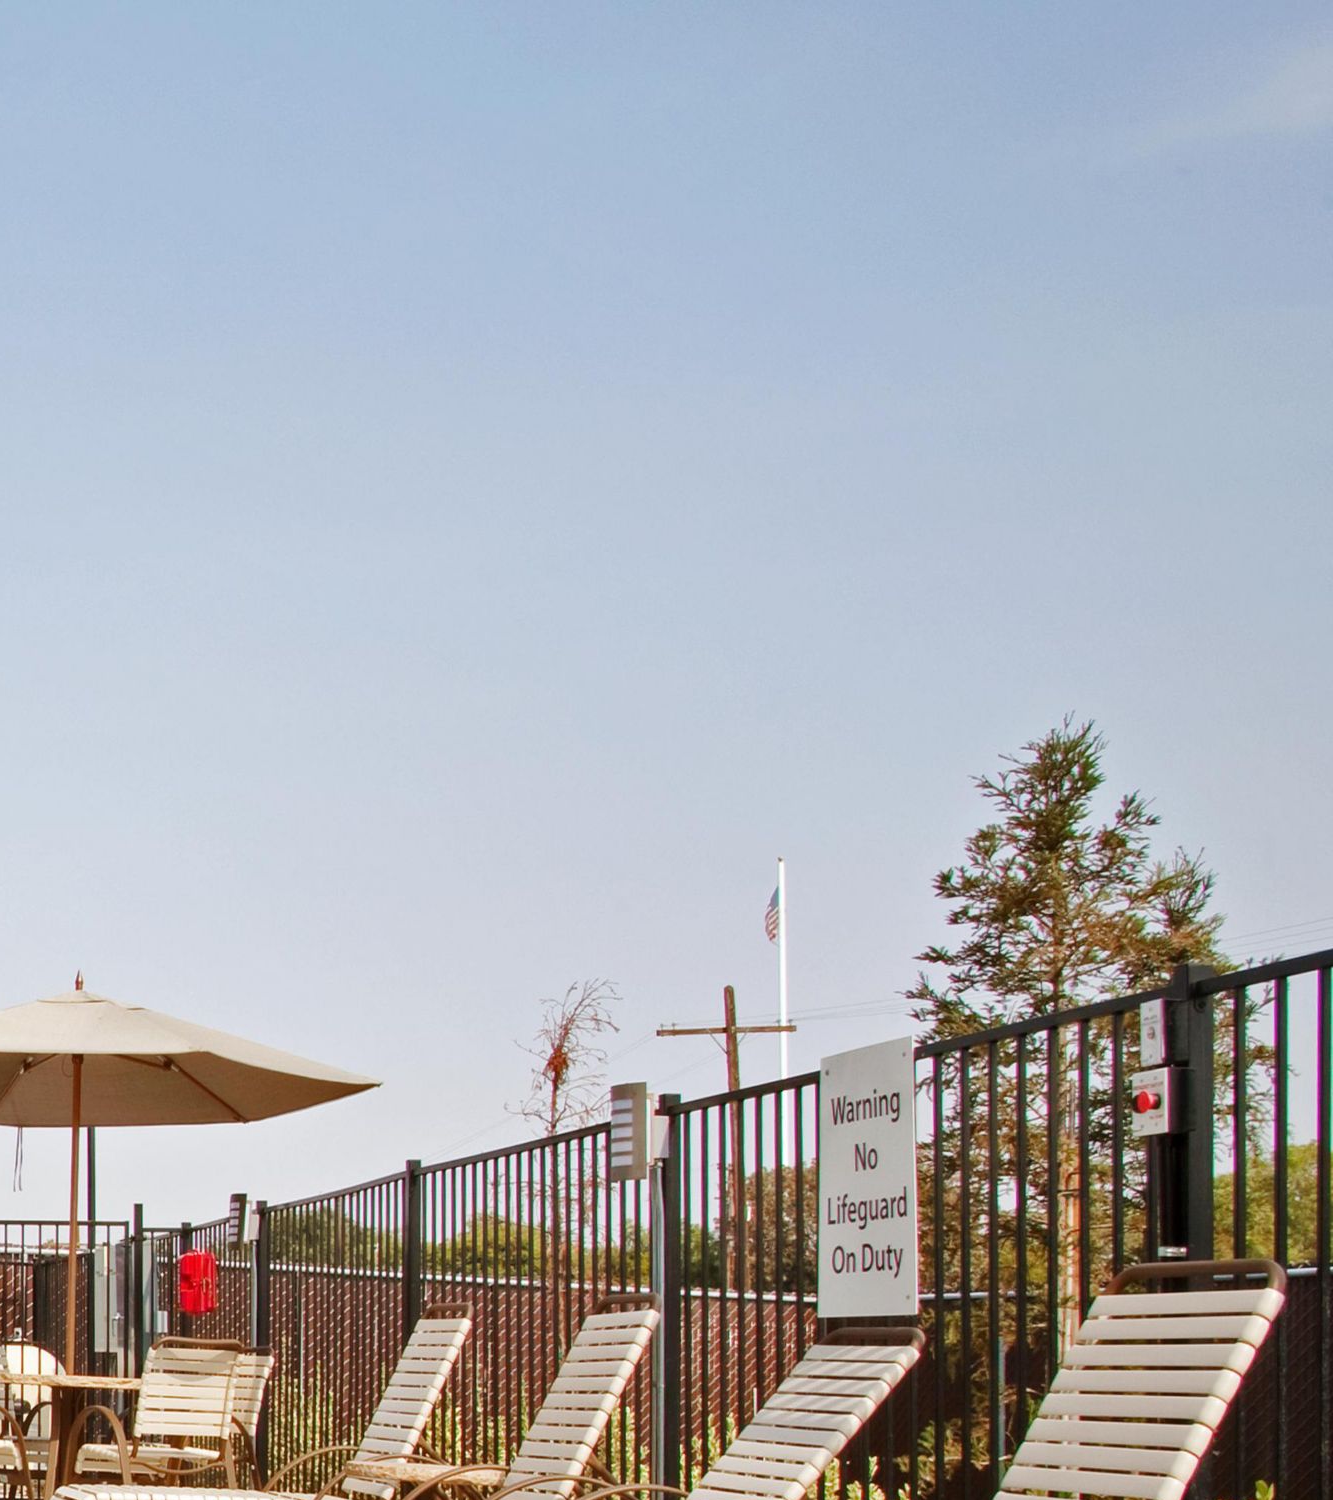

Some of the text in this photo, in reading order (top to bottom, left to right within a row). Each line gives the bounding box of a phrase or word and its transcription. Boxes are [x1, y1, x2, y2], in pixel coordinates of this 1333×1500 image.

[830, 1088, 901, 1126] Warning
[854, 1142, 878, 1172] No
[827, 1186, 908, 1230] Lifeguard
[832, 1243, 903, 1278] On Duty
